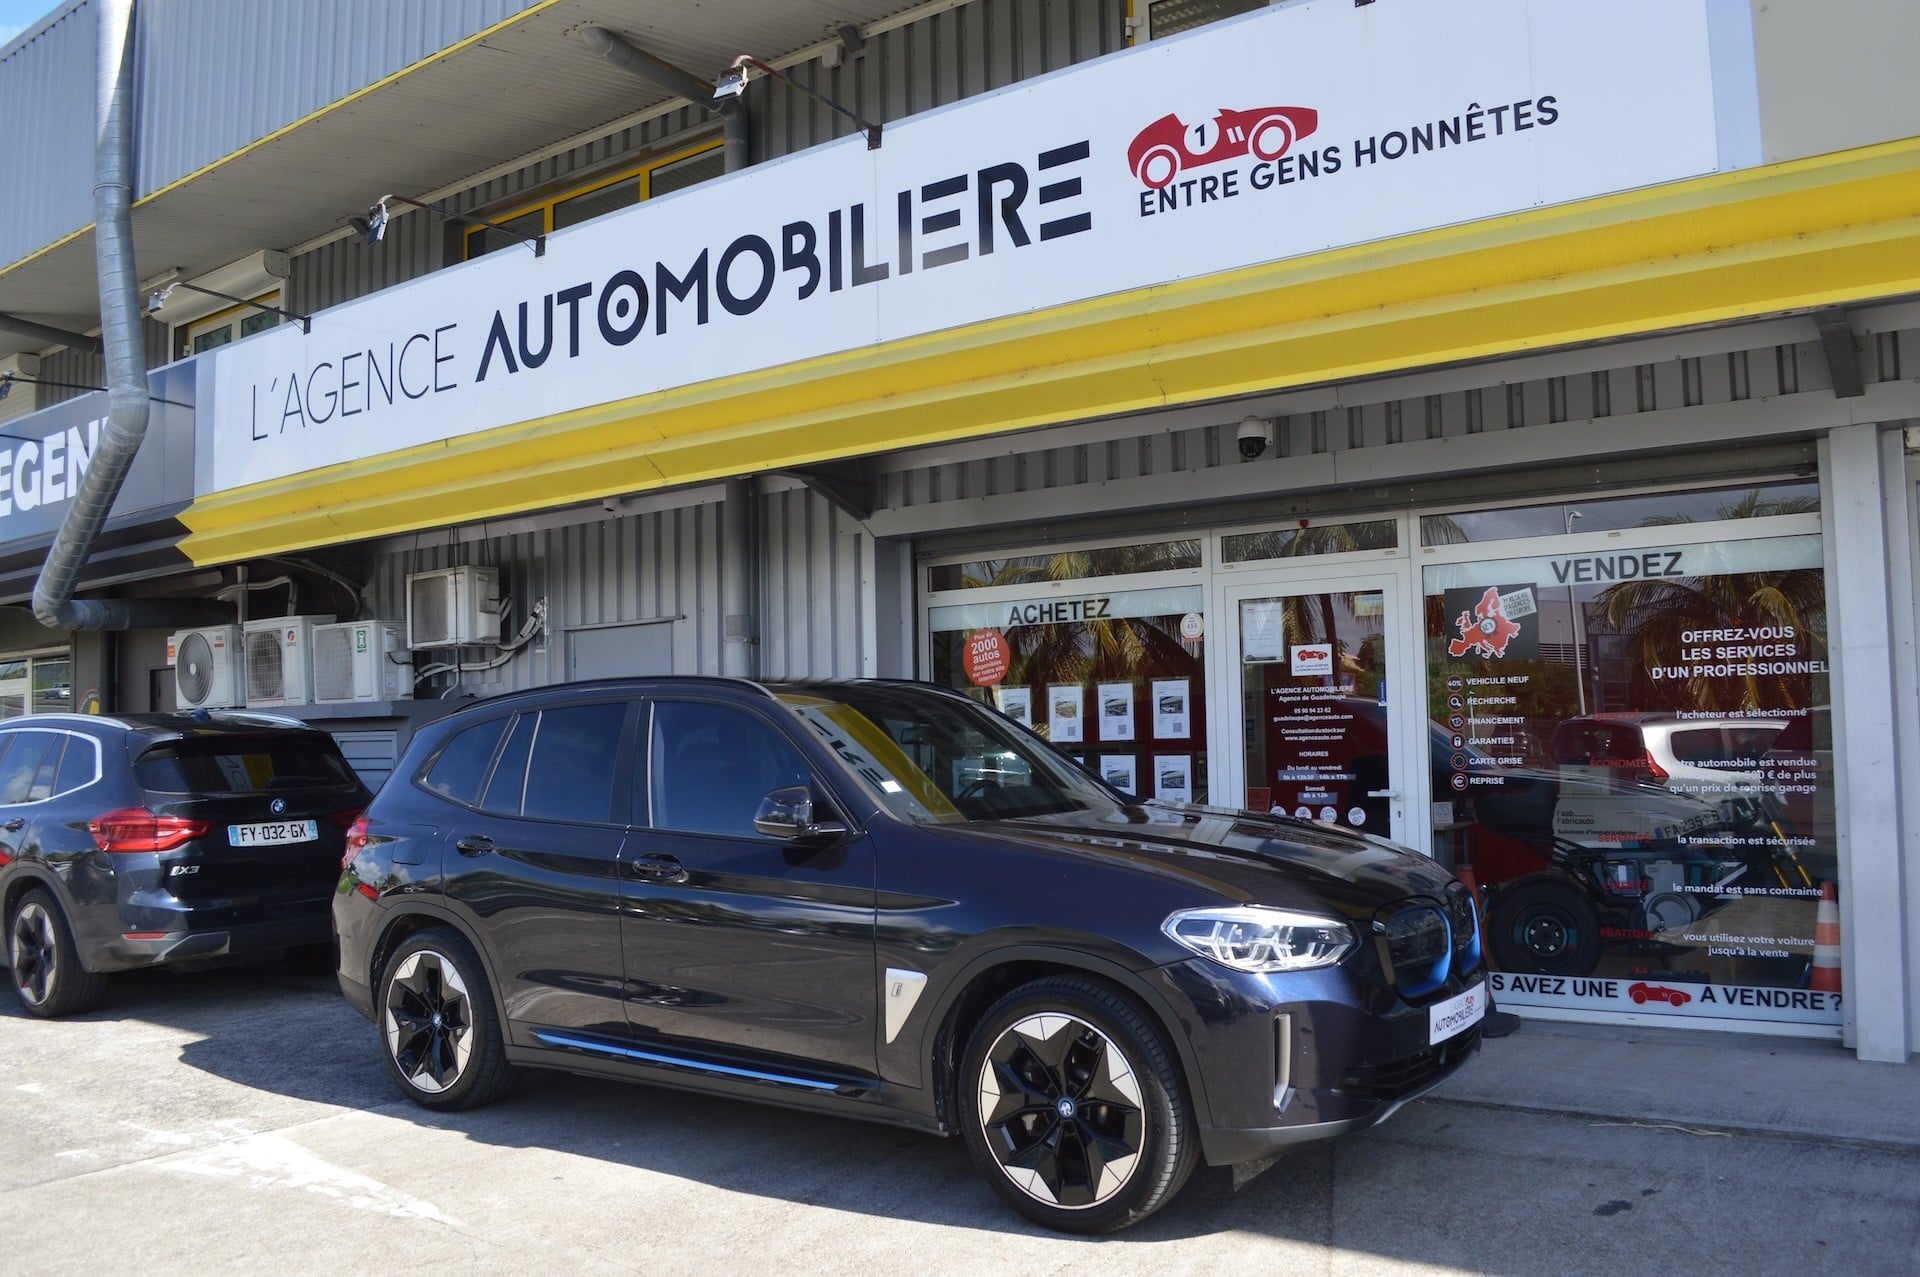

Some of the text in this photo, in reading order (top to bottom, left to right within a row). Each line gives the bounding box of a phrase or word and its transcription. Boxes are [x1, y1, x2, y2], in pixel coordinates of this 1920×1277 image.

[1195, 123, 1206, 147] 1
[1140, 95, 1559, 217] ENTRE GENS HONNÊTES
[252, 139, 1092, 441] L'AGENCE AUTOMOBILIERE
[0, 416, 109, 517] EGEN
[1551, 551, 1684, 584] VENDEZ
[1008, 598, 1111, 625] ACHETEZ
[1681, 626, 1795, 644] OFFREZ-VOUS
[971, 637, 998, 655] 2000
[1681, 644, 1796, 661] LES SERVICES
[973, 650, 1000, 664] autos
[1652, 660, 1829, 680] D'UN PROFESSIONNEL
[1466, 676, 1529, 686] VEHICULE NEUF
[1279, 695, 1301, 703] Agence
[1310, 694, 1346, 702] Guadeloupe
[1467, 697, 1517, 705] RECHERCHE
[1676, 707, 1807, 720] l'acheteur est sélectionné
[1468, 716, 1525, 725] FINANCEMENT
[1468, 737, 1515, 745] GARANTIES
[1469, 757, 1523, 765] CARTE GRISE
[1697, 757, 1757, 767] automobile
[1759, 759, 1775, 767] est
[1777, 757, 1818, 767] vendue
[1470, 777, 1505, 785] REPRISE
[1767, 770, 1776, 779] €
[1777, 770, 1791, 780] de
[1793, 770, 1817, 781] plus
[1670, 783, 1699, 794] qu'un
[1703, 783, 1721, 794] prix
[1723, 783, 1736, 792] de
[1778, 784, 1817, 795] garage
[1556, 817, 1595, 825] Fabricauto
[1677, 835, 1686, 844] la
[1688, 835, 1745, 845] transaction
[1748, 837, 1764, 845] est
[1766, 835, 1816, 846] sécurisée
[1672, 883, 1683, 892] le
[1684, 883, 1724, 894] mandat
[1726, 886, 1742, 894] est
[1744, 887, 1767, 895] sans
[1769, 887, 1823, 897] contrainte
[1683, 934, 1707, 942] vous
[1709, 933, 1745, 943] utilisez
[1749, 936, 1775, 945] votre
[1777, 936, 1815, 946] voiture
[1707, 945, 1789, 958] jusqu'à la vente
[1511, 975, 1566, 995] AVEZ
[1573, 979, 1619, 998] UNE
[1700, 986, 1717, 1003] A
[1723, 987, 1825, 1011] VENDRE
